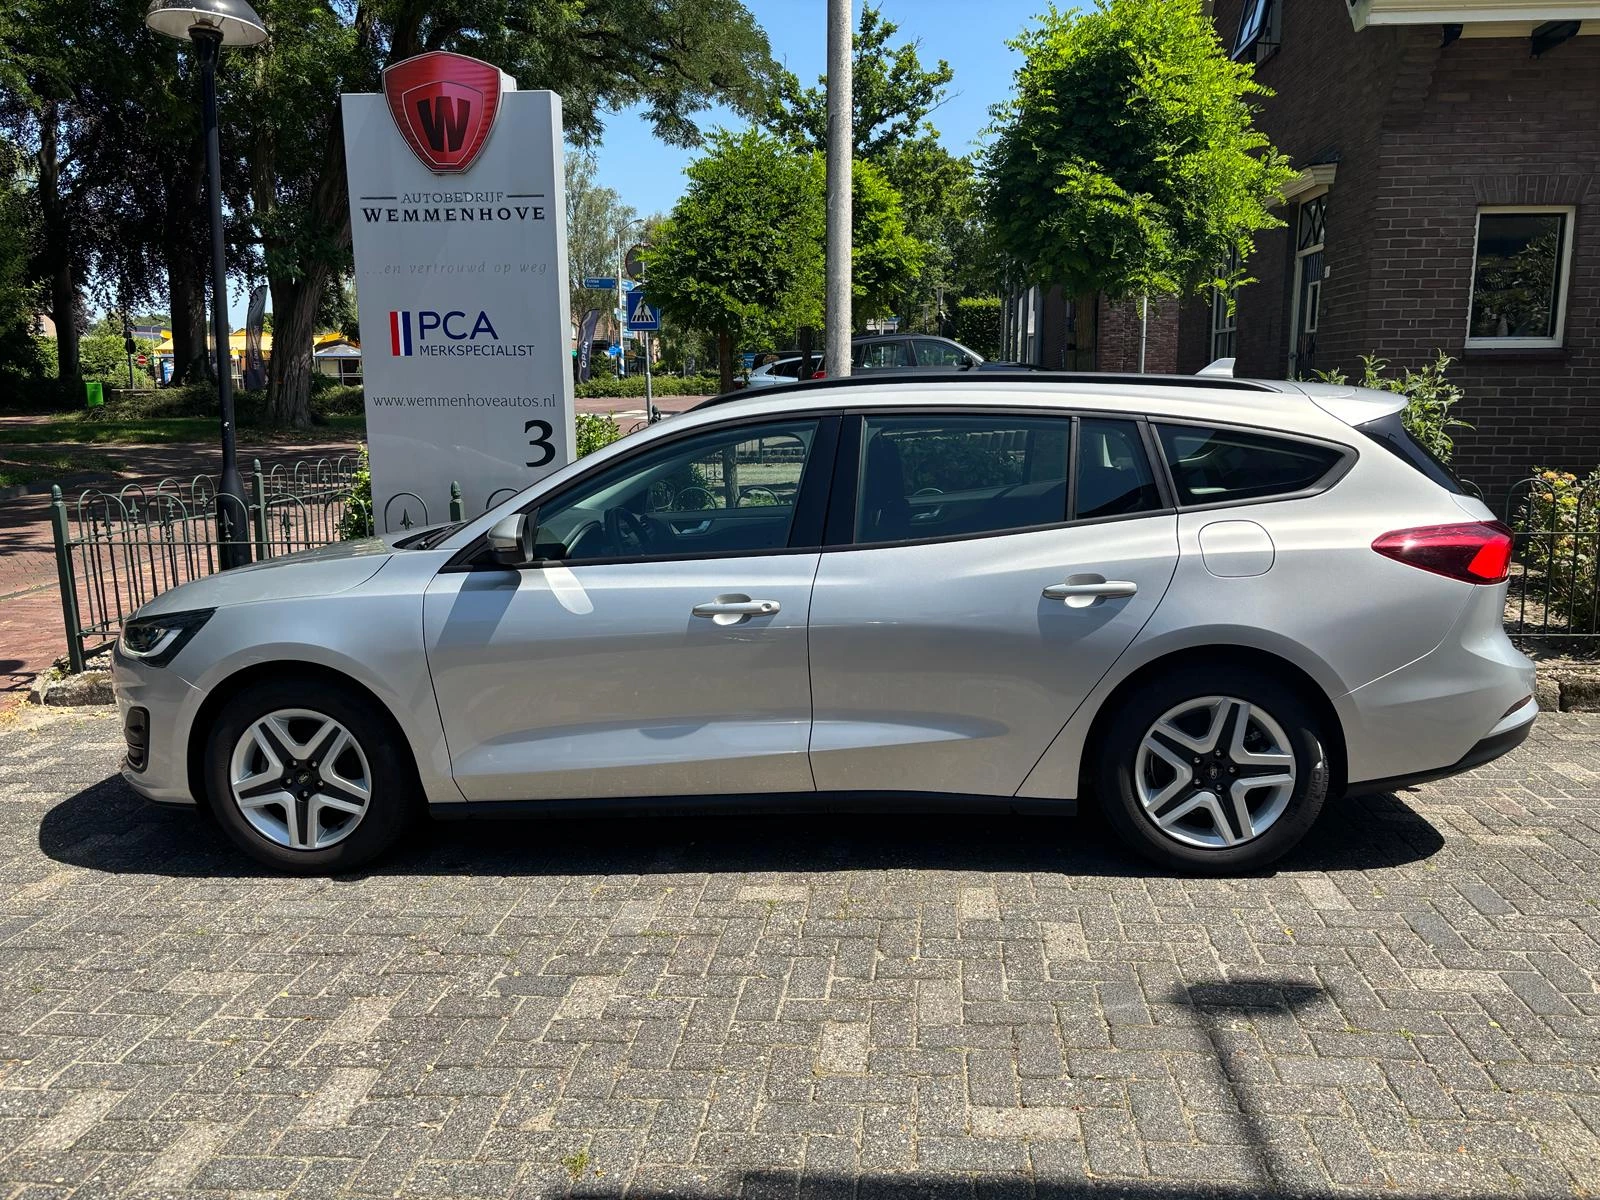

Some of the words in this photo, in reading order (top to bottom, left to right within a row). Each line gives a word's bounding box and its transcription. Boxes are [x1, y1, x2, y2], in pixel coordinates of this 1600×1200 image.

[417, 96, 471, 152] W
[401, 191, 504, 204] AUTOBEDRIJF
[362, 207, 545, 223] WEMMENHOVE
[409, 262, 487, 275] vertrouwd
[494, 263, 512, 275] op
[519, 262, 548, 274] weg
[418, 311, 499, 340] PCA
[419, 344, 535, 357] MERKSPECIALIST
[581, 341, 589, 368] OPEN
[373, 394, 556, 408] www.wemmenhoveautos.nl
[524, 419, 556, 468] 3
